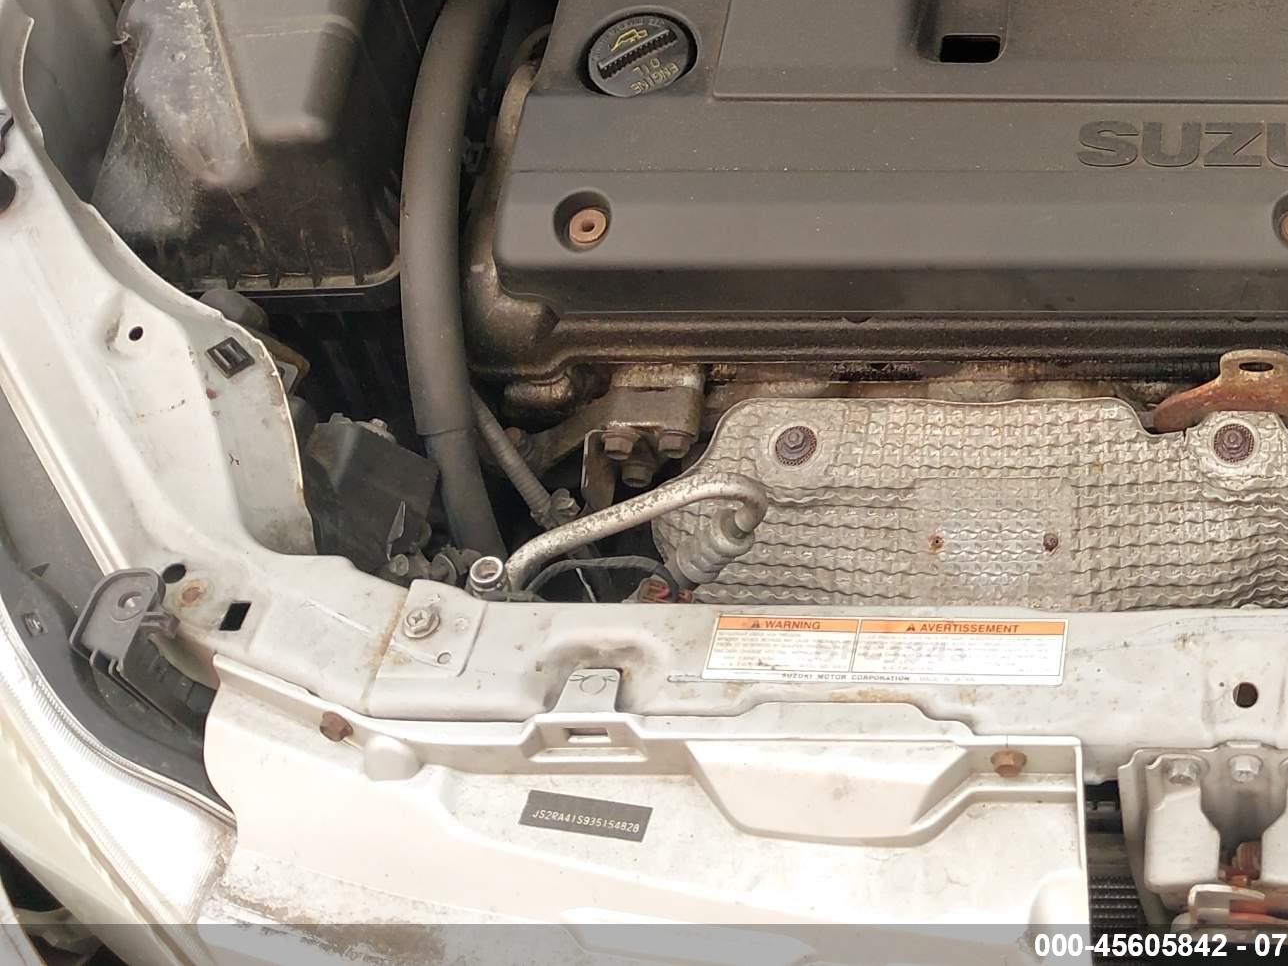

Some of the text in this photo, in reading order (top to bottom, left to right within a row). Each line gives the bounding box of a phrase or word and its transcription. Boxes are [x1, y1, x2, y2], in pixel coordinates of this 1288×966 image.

[764, 620, 1021, 634] WARNING AVERTISSEMENT
[532, 809, 640, 834] JS2RA41S935154828
